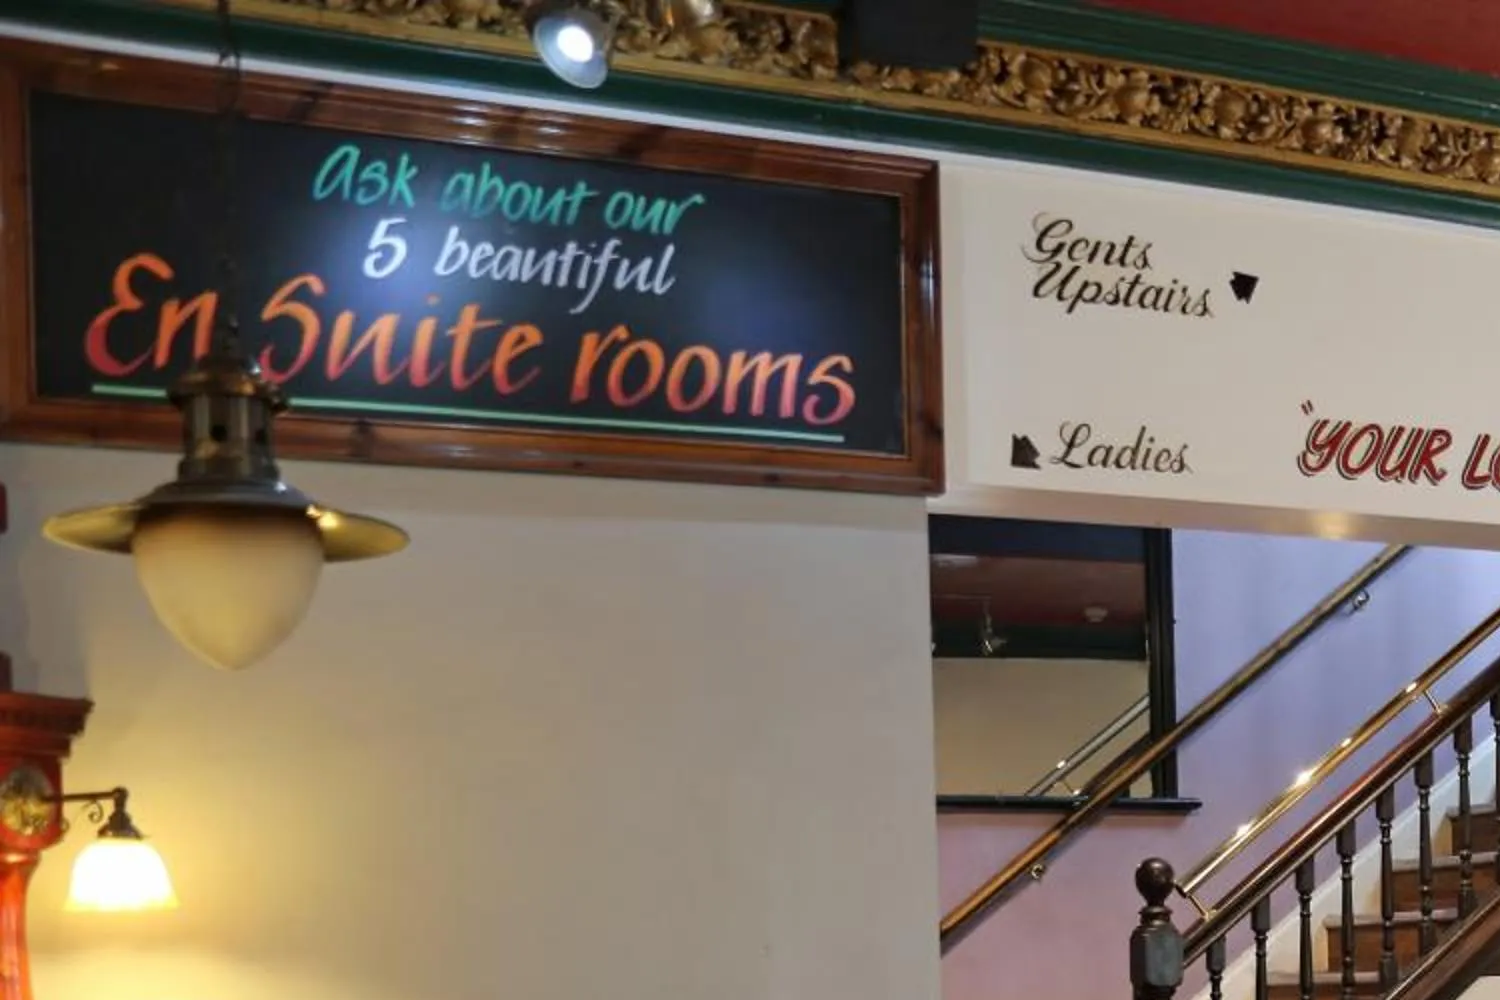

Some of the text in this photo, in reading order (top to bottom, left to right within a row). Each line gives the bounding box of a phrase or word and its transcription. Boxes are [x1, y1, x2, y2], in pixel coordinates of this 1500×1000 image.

[440, 162, 600, 228] about
[604, 191, 705, 235] our
[362, 217, 677, 315] 5 beautiful
[1020, 212, 1152, 270] Gents
[1033, 261, 1214, 318] Upstairs
[85, 253, 856, 426] En Suite rooms
[1050, 422, 1193, 475] Ladies
